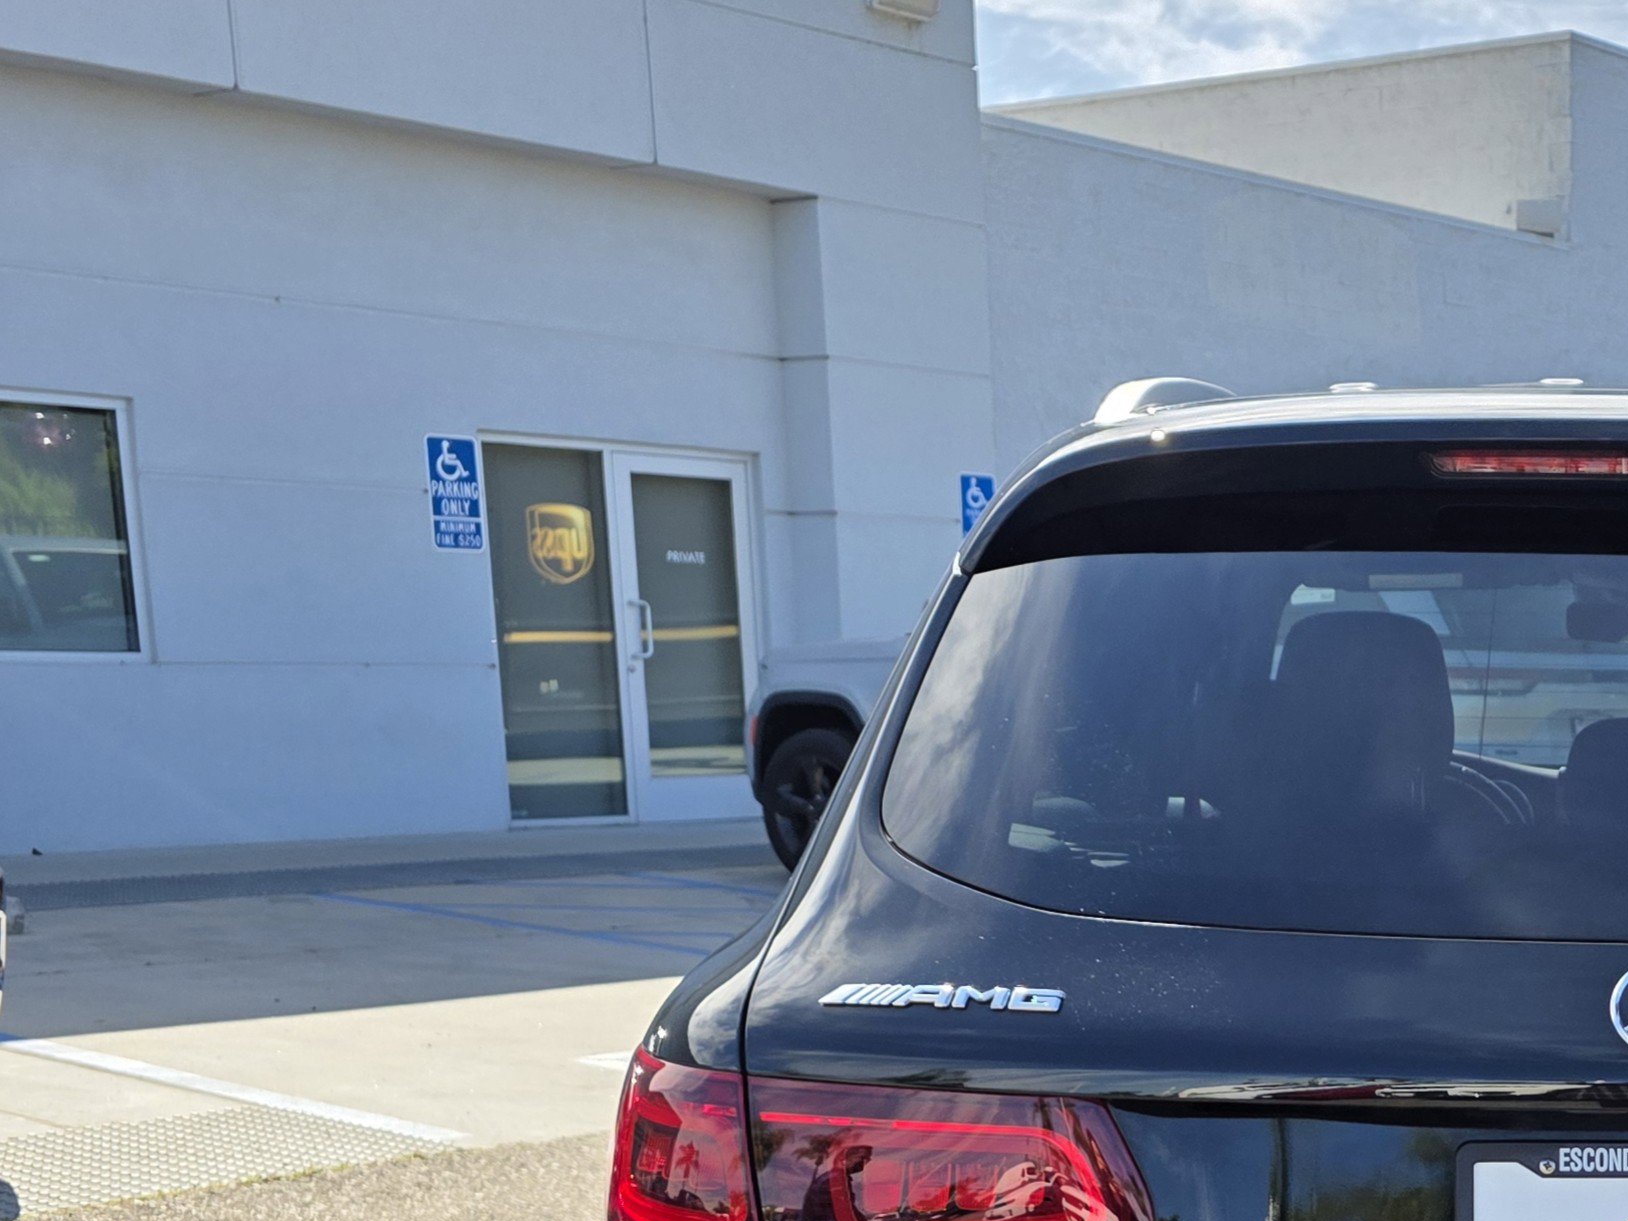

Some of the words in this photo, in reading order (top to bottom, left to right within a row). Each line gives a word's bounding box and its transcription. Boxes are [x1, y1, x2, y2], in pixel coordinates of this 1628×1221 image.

[431, 481, 479, 499] PARKING
[441, 499, 470, 516] ONLY
[440, 521, 477, 534] MINIMUM
[666, 550, 705, 564] PRIVATE
[892, 984, 1066, 1012] AMG
